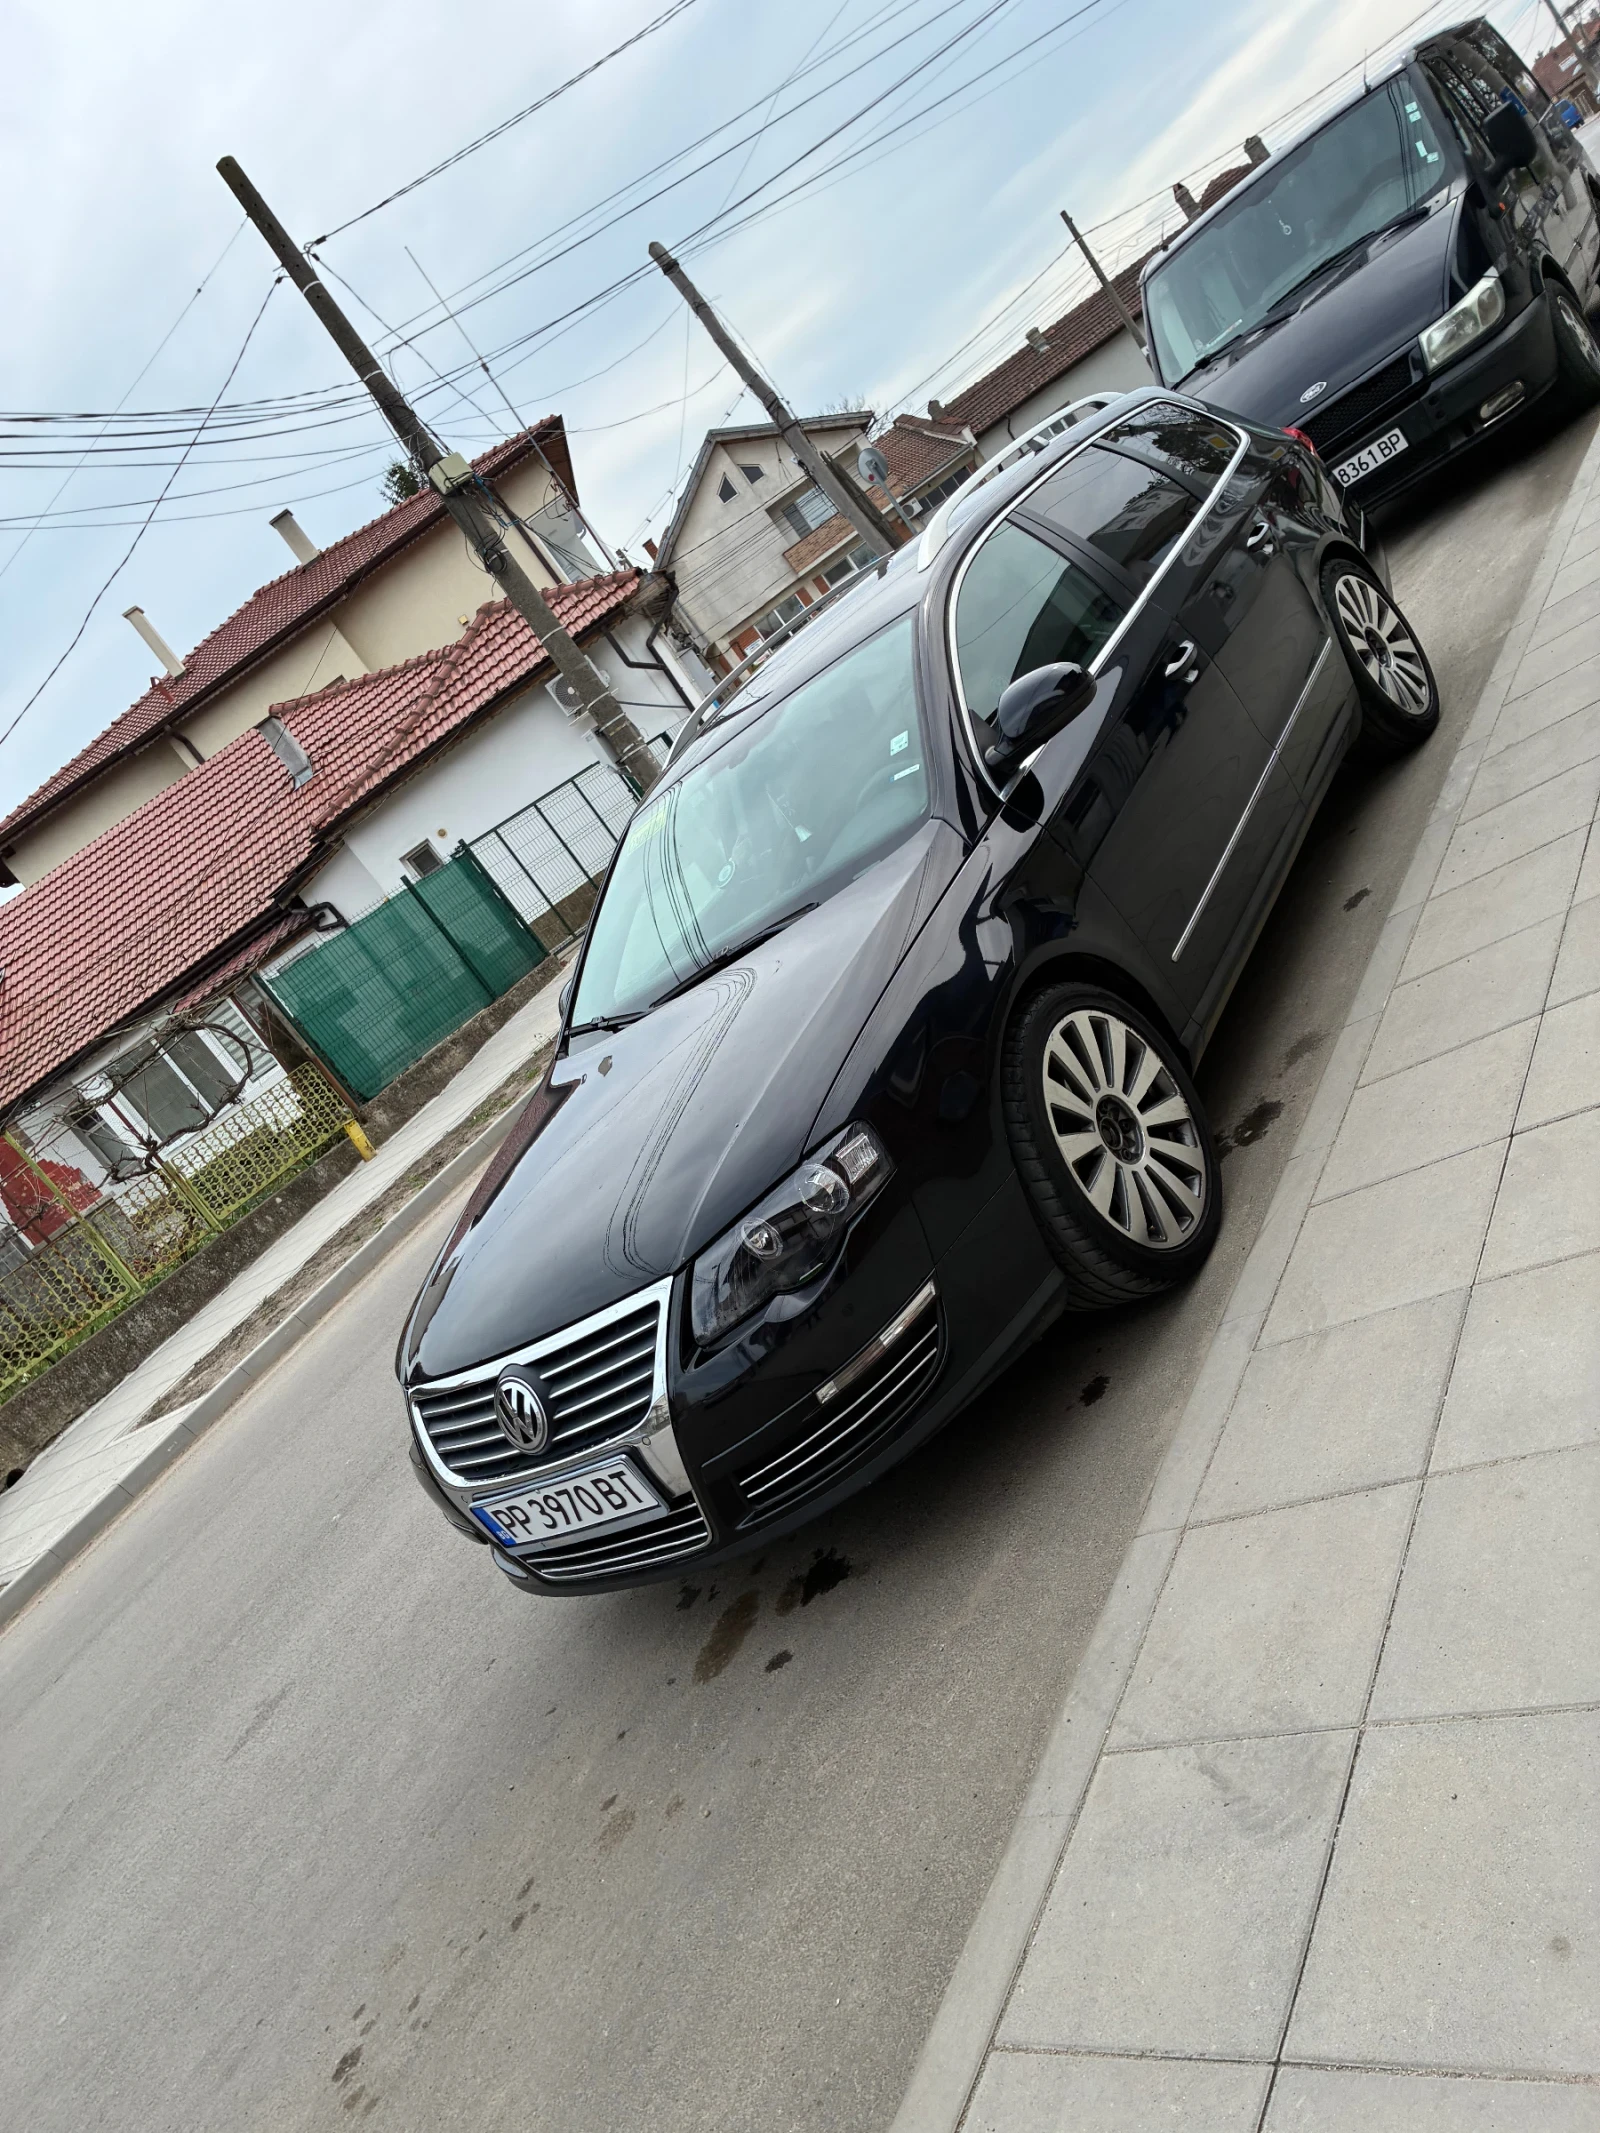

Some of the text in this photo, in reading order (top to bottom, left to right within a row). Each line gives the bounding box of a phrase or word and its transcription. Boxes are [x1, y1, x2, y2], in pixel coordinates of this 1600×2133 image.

[1338, 433, 1400, 484] 8361 BP
[490, 1471, 643, 1538] PP 3970 BT
